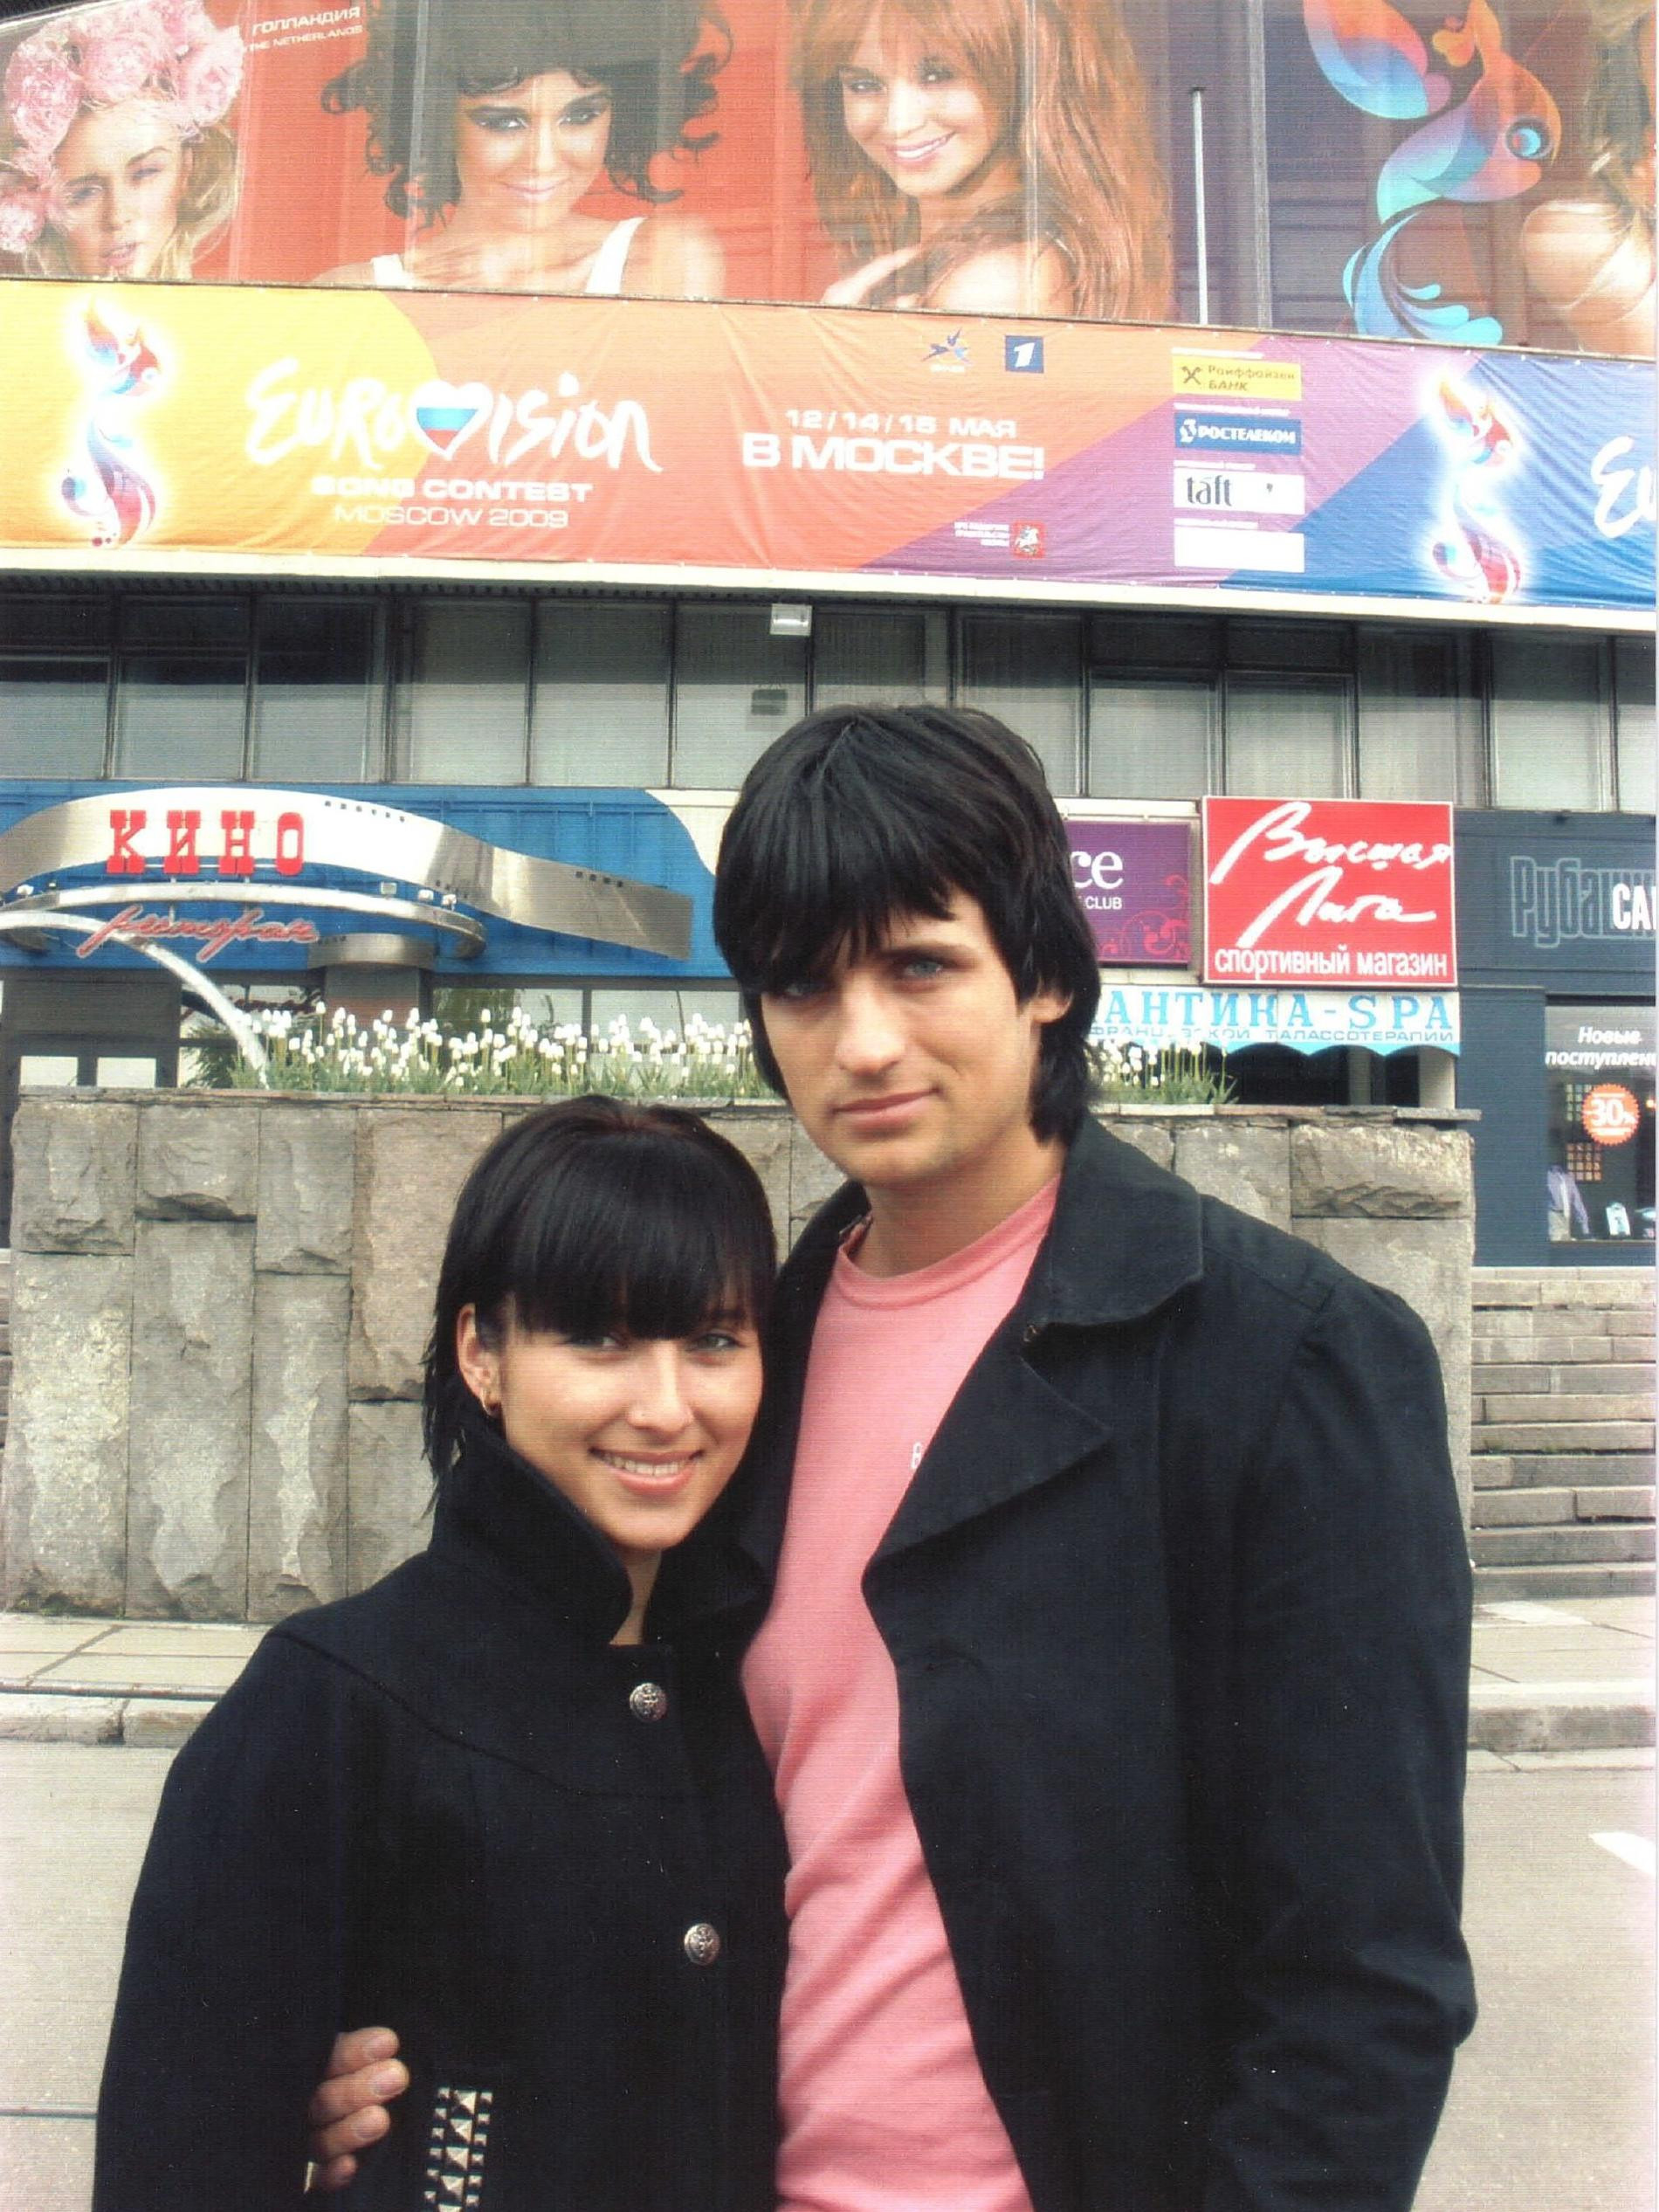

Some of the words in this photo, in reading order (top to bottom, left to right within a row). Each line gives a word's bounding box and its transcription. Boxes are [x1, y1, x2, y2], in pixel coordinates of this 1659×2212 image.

[251, 6, 361, 36] ГОЛЛАНДИЯ
[273, 24, 363, 46] NETHERLANDS
[1208, 379, 1249, 391] БАНК
[948, 417, 1017, 438] МАЯ
[742, 431, 781, 467] В
[791, 434, 1045, 480] МОСКВЕ!
[310, 475, 416, 499] SONG
[423, 479, 594, 503] CONTEST
[334, 504, 484, 527] MOSCOW
[489, 508, 569, 527] 2009
[106, 810, 305, 876] КИНО
[1085, 895, 1123, 910] CLUB
[1091, 1026, 1250, 1039] ФРАНЦЗКОЙ
[1578, 1026, 1642, 1044] Новые
